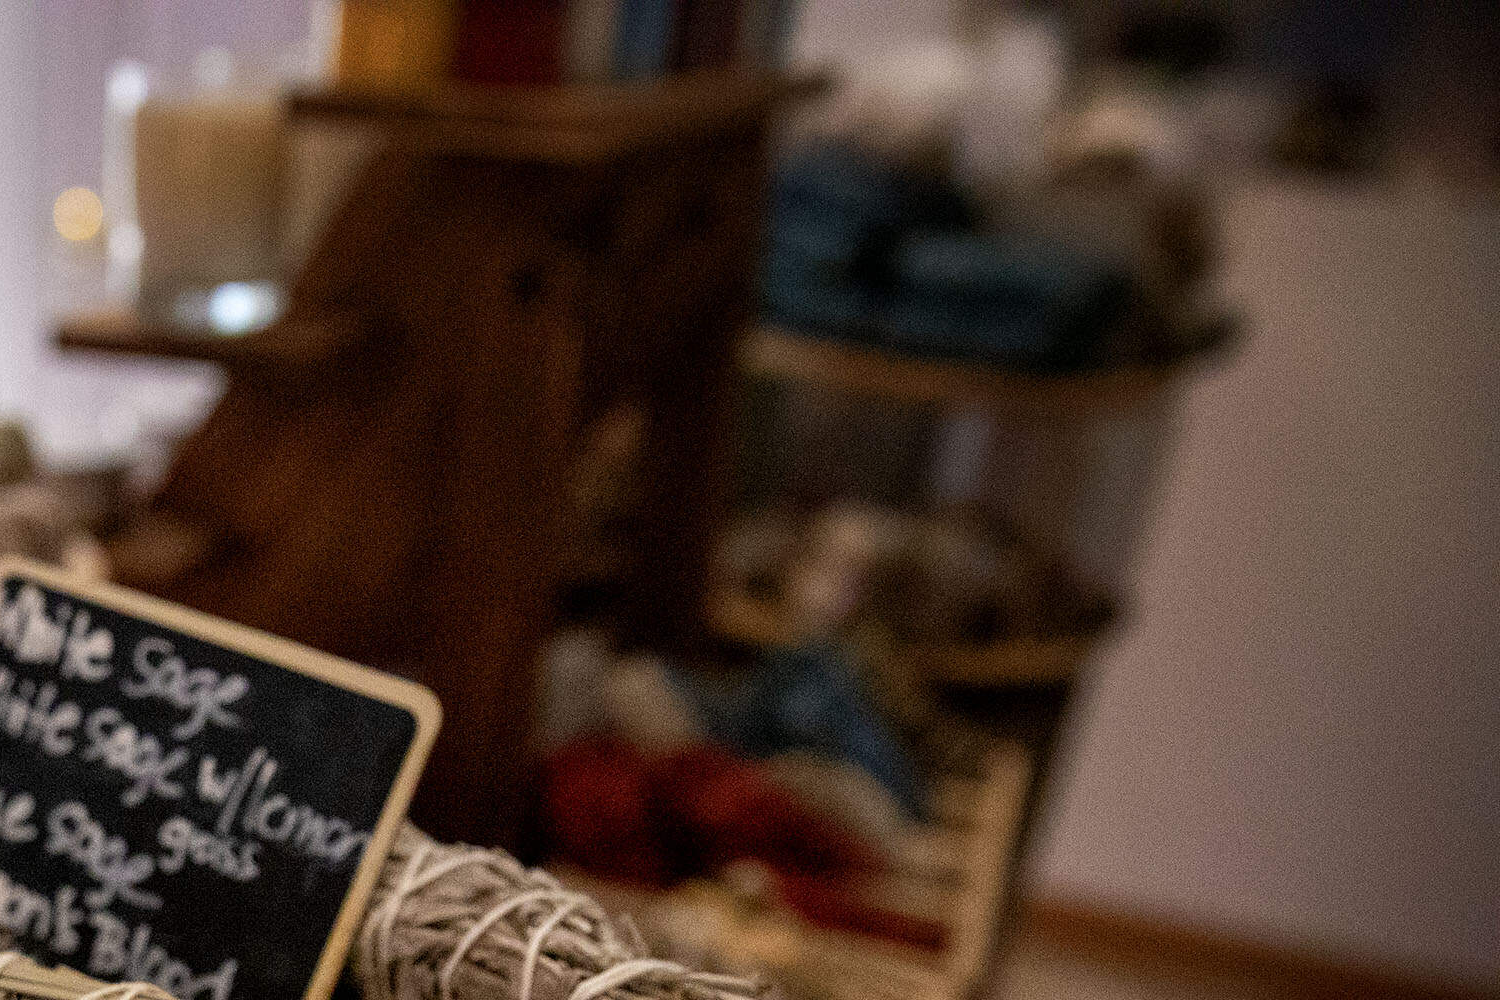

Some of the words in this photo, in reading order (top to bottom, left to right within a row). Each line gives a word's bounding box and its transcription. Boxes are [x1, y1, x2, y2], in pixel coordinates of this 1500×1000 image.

[119, 636, 249, 740] Sage
[83, 706, 191, 808] Sage
[46, 802, 165, 911] Sage
